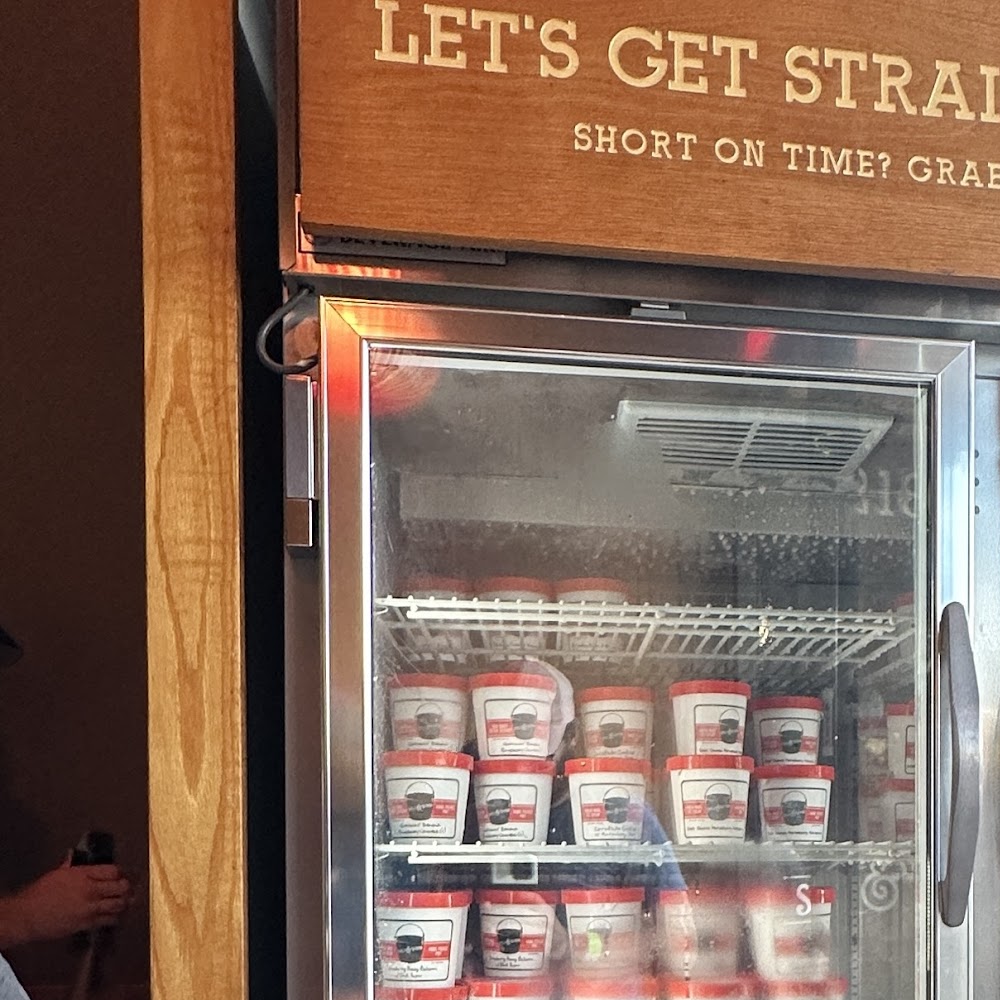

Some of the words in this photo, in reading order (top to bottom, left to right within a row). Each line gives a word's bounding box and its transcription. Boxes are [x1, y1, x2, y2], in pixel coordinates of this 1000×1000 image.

[374, 0, 580, 79] LET'S
[608, 26, 758, 98] GET
[573, 122, 699, 161] SHORT
[714, 137, 766, 168] ON
[782, 141, 893, 179] TIME?
